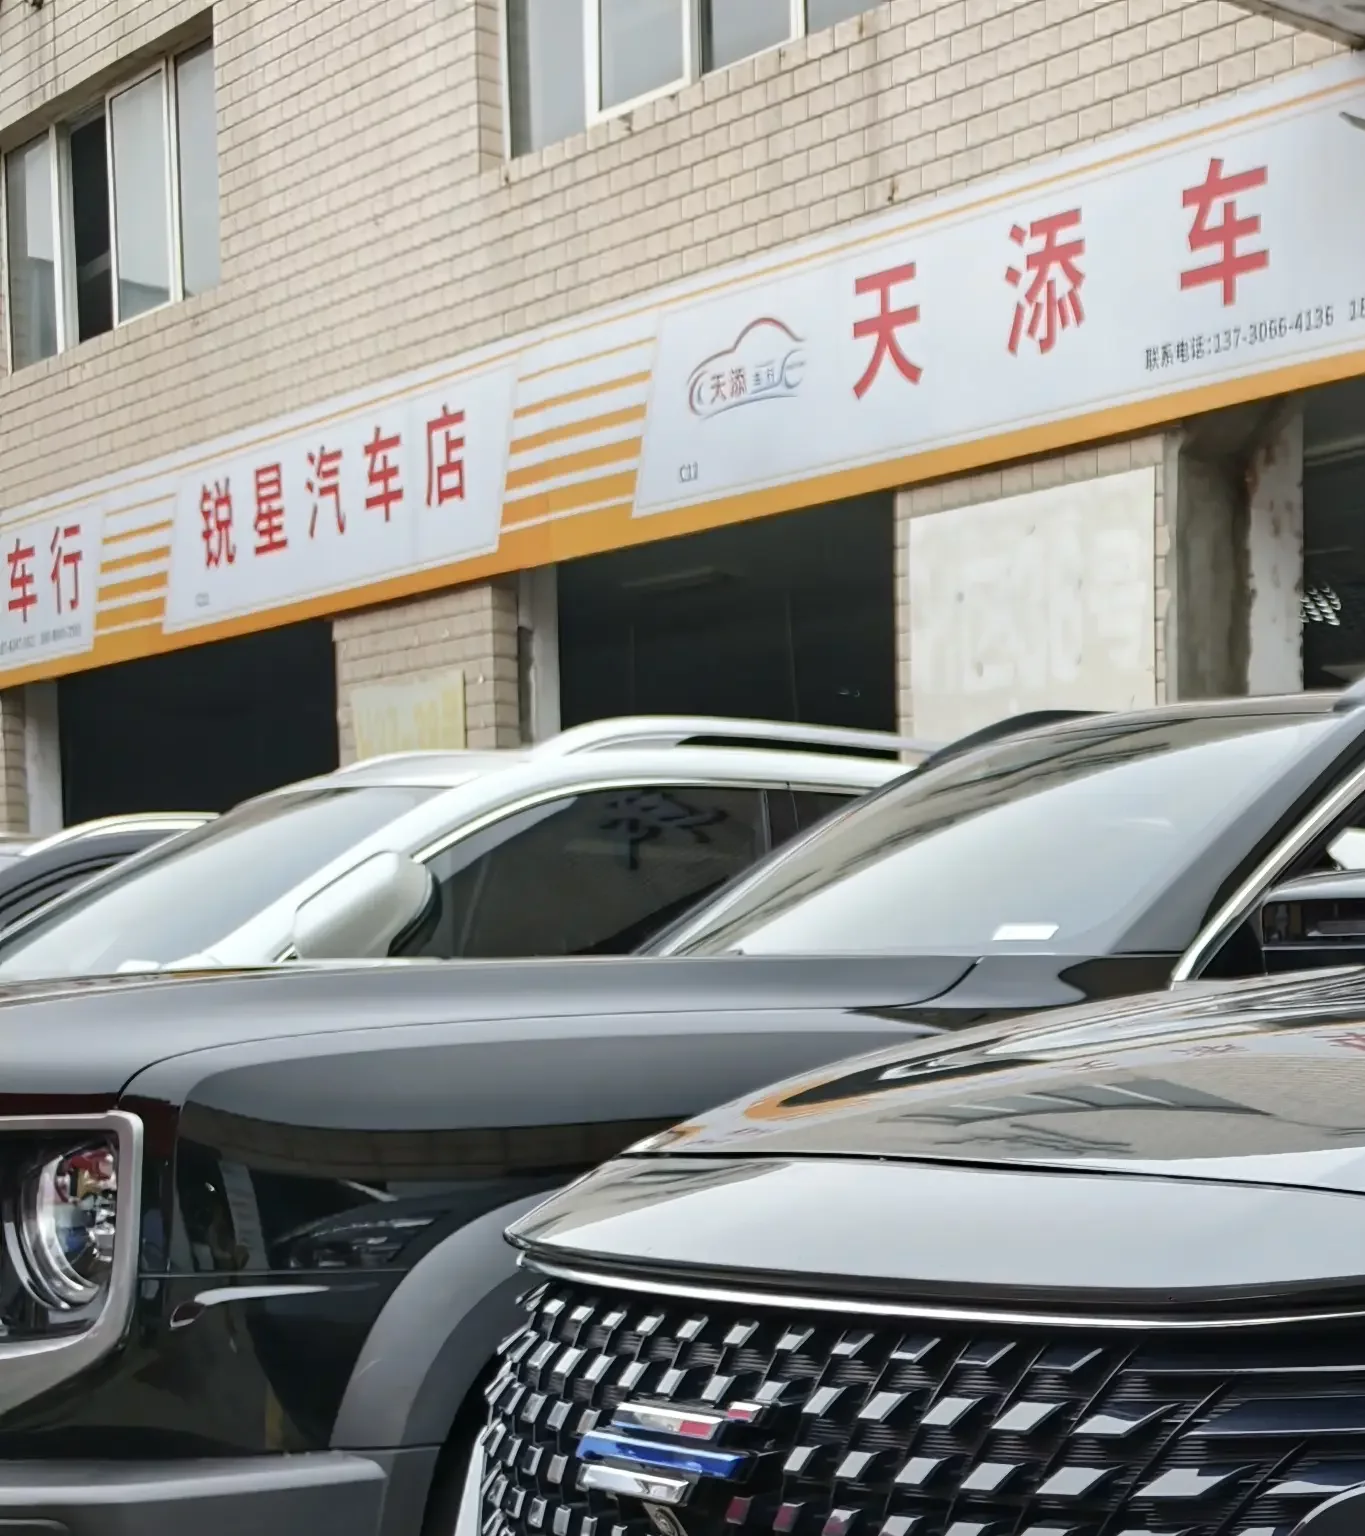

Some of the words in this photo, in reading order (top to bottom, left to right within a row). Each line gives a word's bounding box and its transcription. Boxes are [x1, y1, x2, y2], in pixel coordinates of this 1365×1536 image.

[200, 403, 466, 568] 锐星汽车店
[7, 524, 83, 624] 车行
